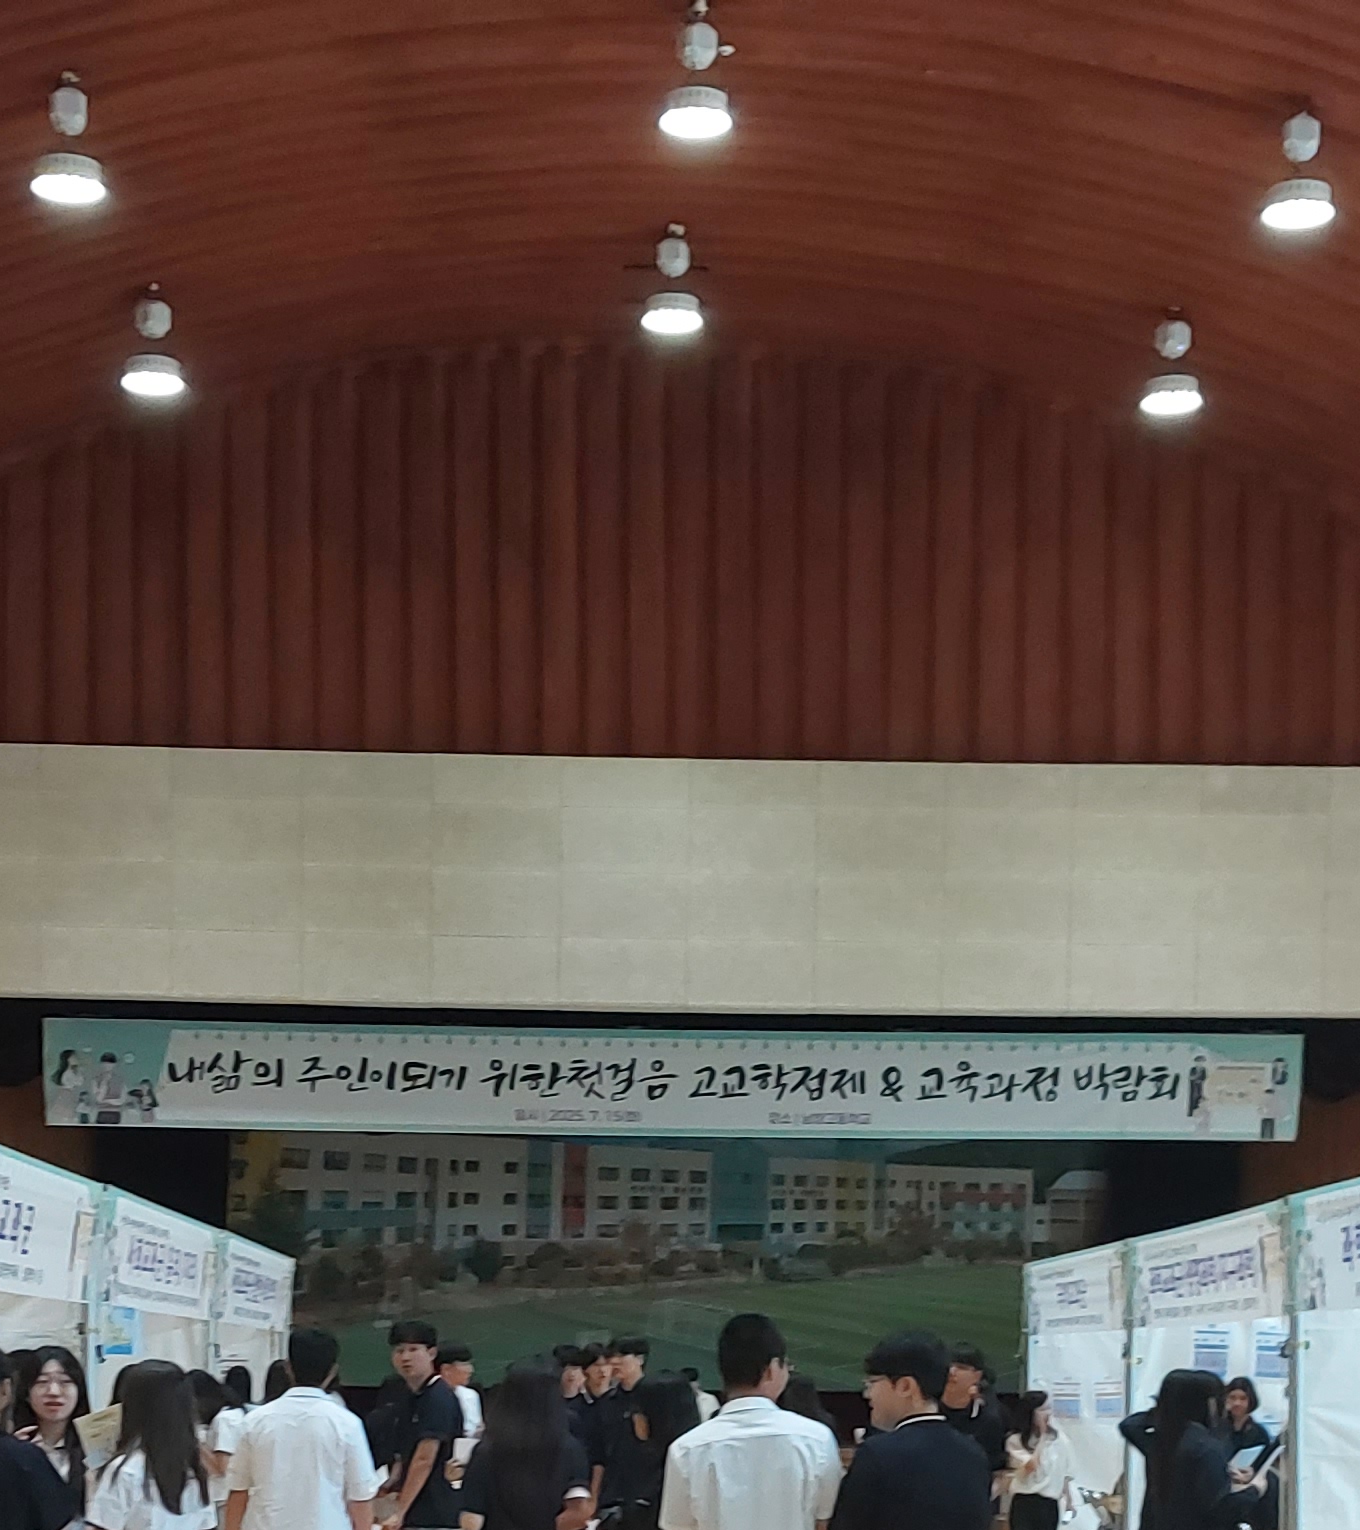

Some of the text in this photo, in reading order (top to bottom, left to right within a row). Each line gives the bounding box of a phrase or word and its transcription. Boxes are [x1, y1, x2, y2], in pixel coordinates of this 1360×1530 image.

[688, 1063, 866, 1102] 고교학점제
[880, 1066, 903, 1102] &
[916, 1061, 1061, 1103] 교육과정
[1074, 1063, 1181, 1102] 박람회
